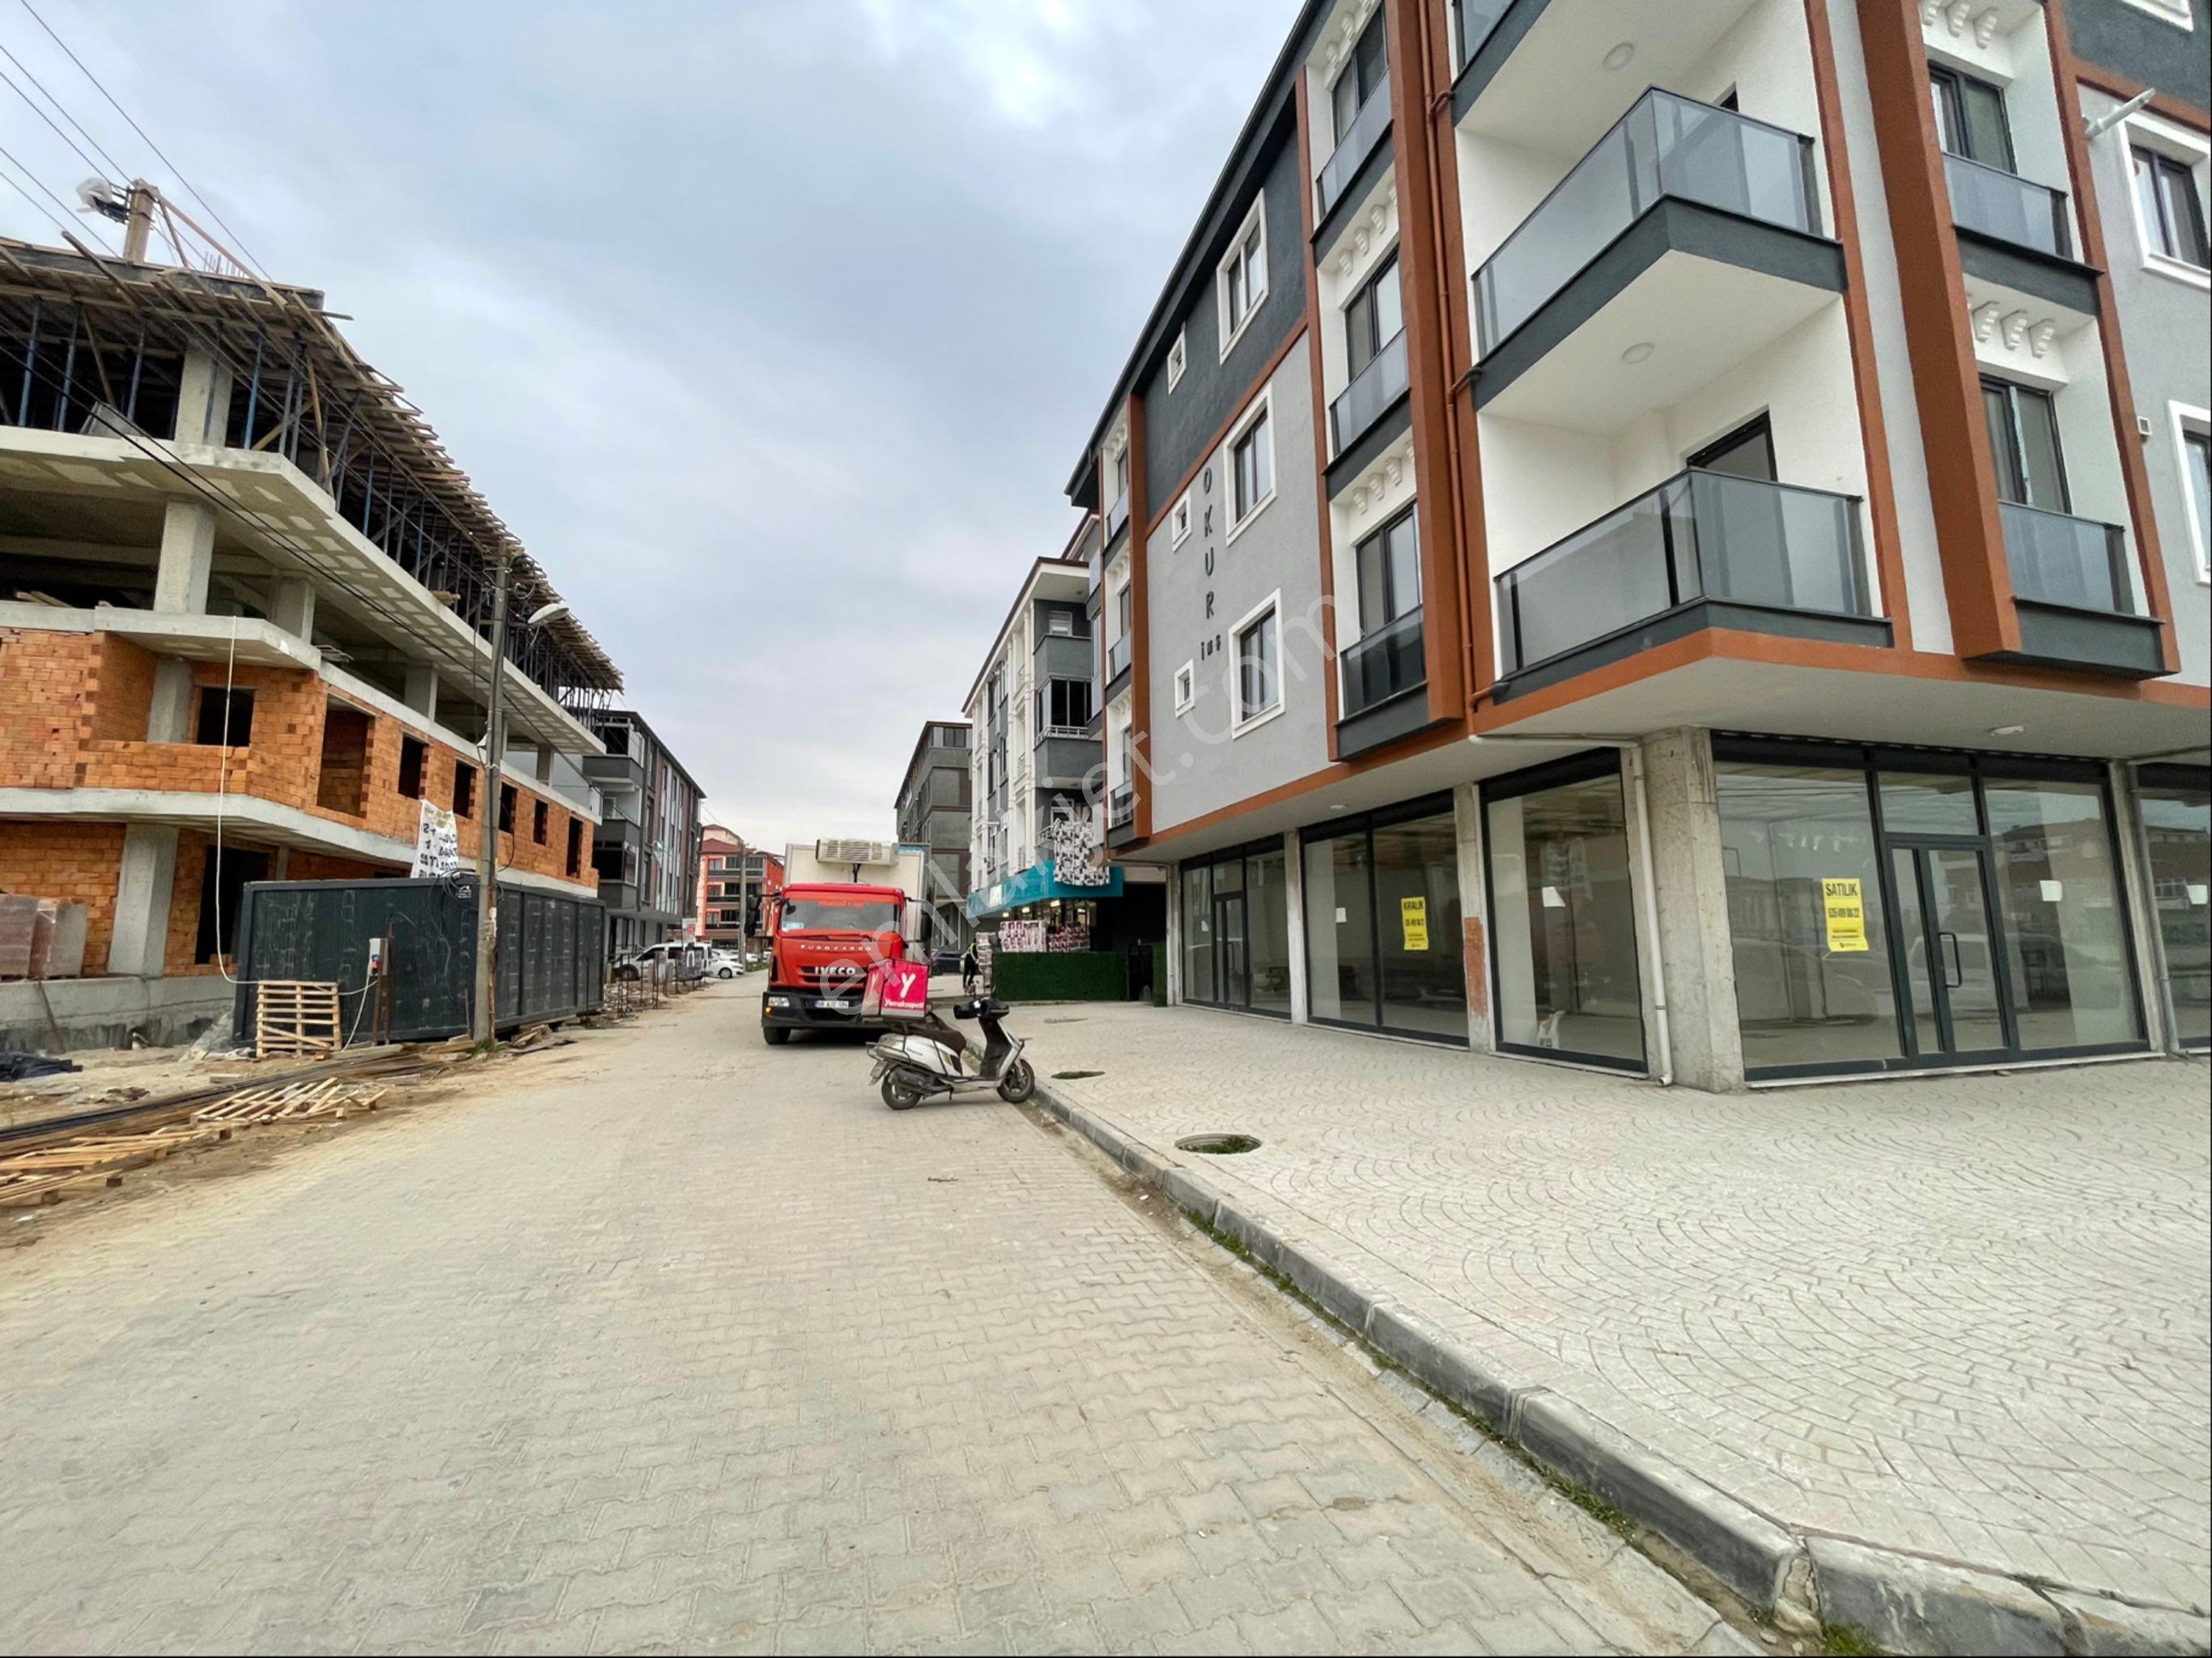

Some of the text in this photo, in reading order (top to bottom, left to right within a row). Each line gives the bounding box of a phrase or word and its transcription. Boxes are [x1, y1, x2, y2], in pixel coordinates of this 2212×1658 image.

[1202, 466, 1215, 621] OKUR
[1826, 883, 1857, 897] SATILIK
[800, 943, 872, 952] EUROCARGO
[814, 965, 856, 975] IVECO
